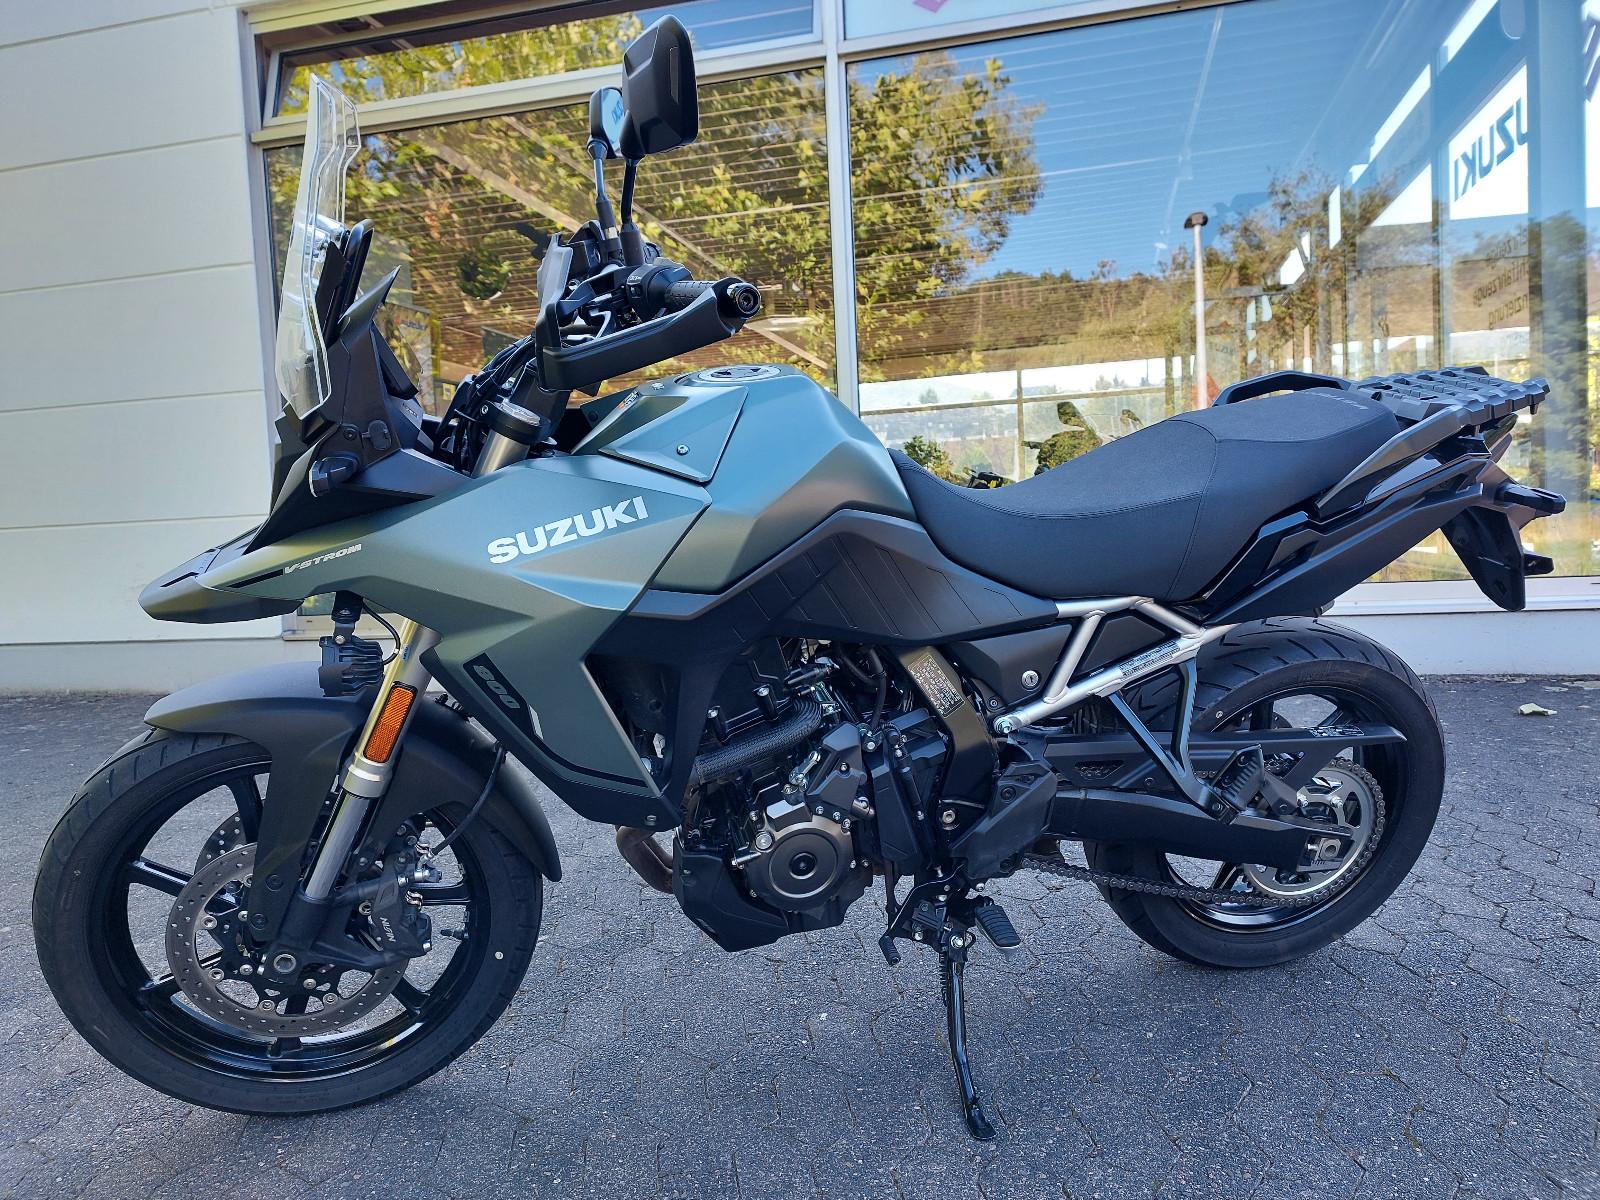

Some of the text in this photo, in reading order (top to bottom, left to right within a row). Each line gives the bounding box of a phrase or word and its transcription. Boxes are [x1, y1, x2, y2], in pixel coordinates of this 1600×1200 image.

[487, 495, 649, 564] SUZUKI
[284, 543, 362, 574] V-STROM
[473, 665, 520, 709] 800
